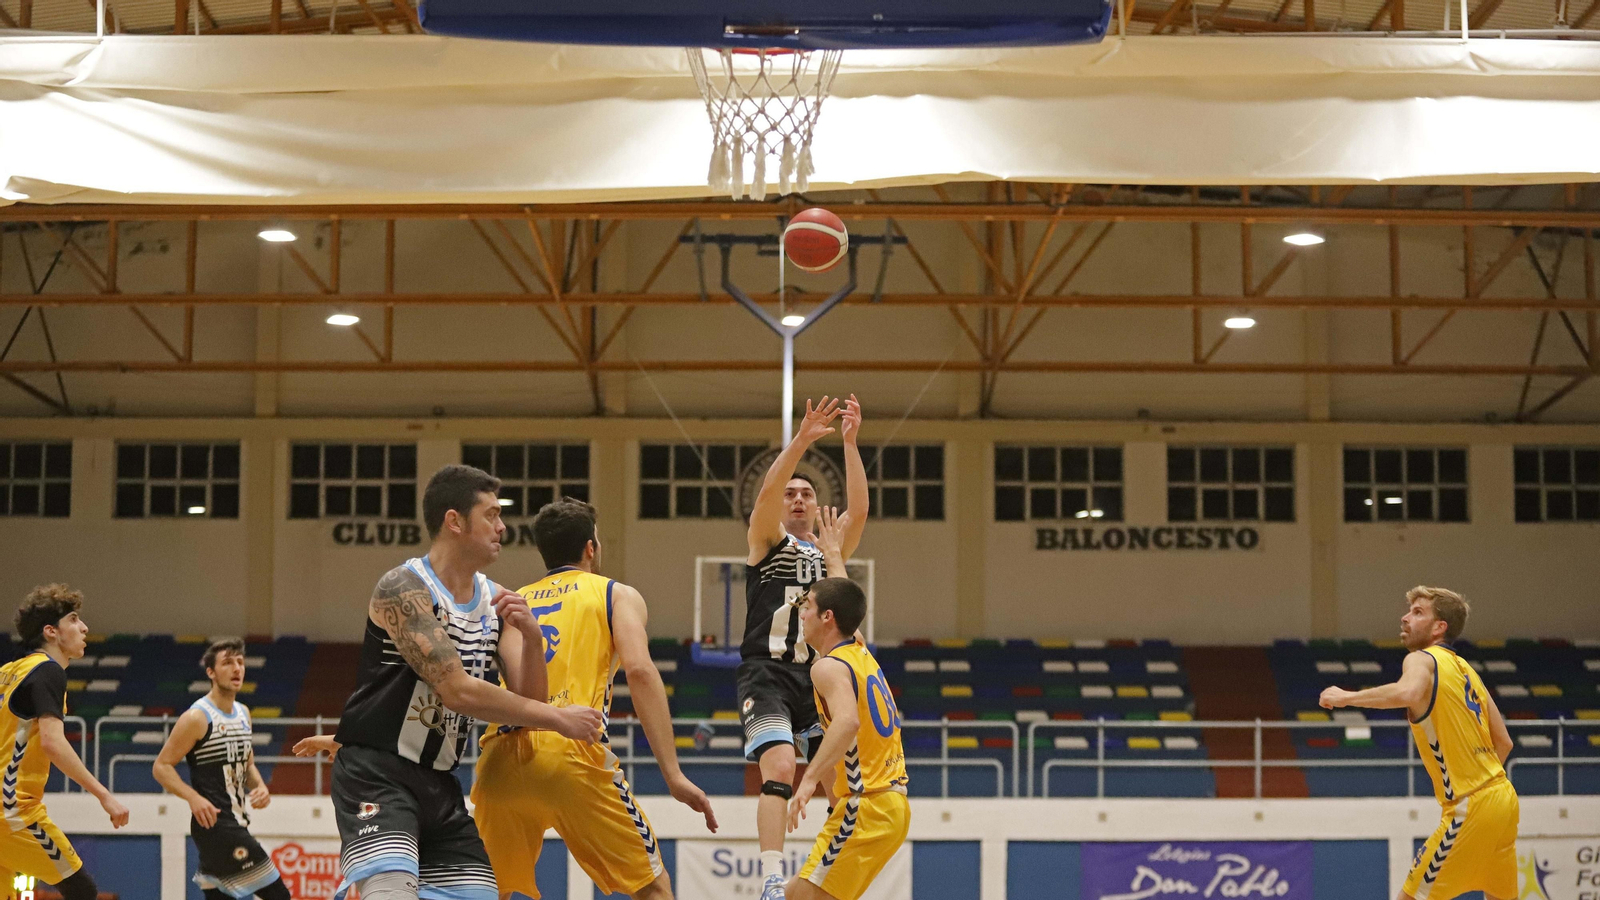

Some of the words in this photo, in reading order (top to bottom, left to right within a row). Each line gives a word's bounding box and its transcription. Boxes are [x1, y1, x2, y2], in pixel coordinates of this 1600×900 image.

[333, 523, 421, 545] CLUB
[1036, 528, 1259, 549] BALONCESTO
[524, 582, 579, 600] CHEMA
[1464, 674, 1482, 726] 4
[359, 825, 379, 836] vive
[1100, 865, 1198, 900] Don
[1204, 853, 1288, 897] Pablo
